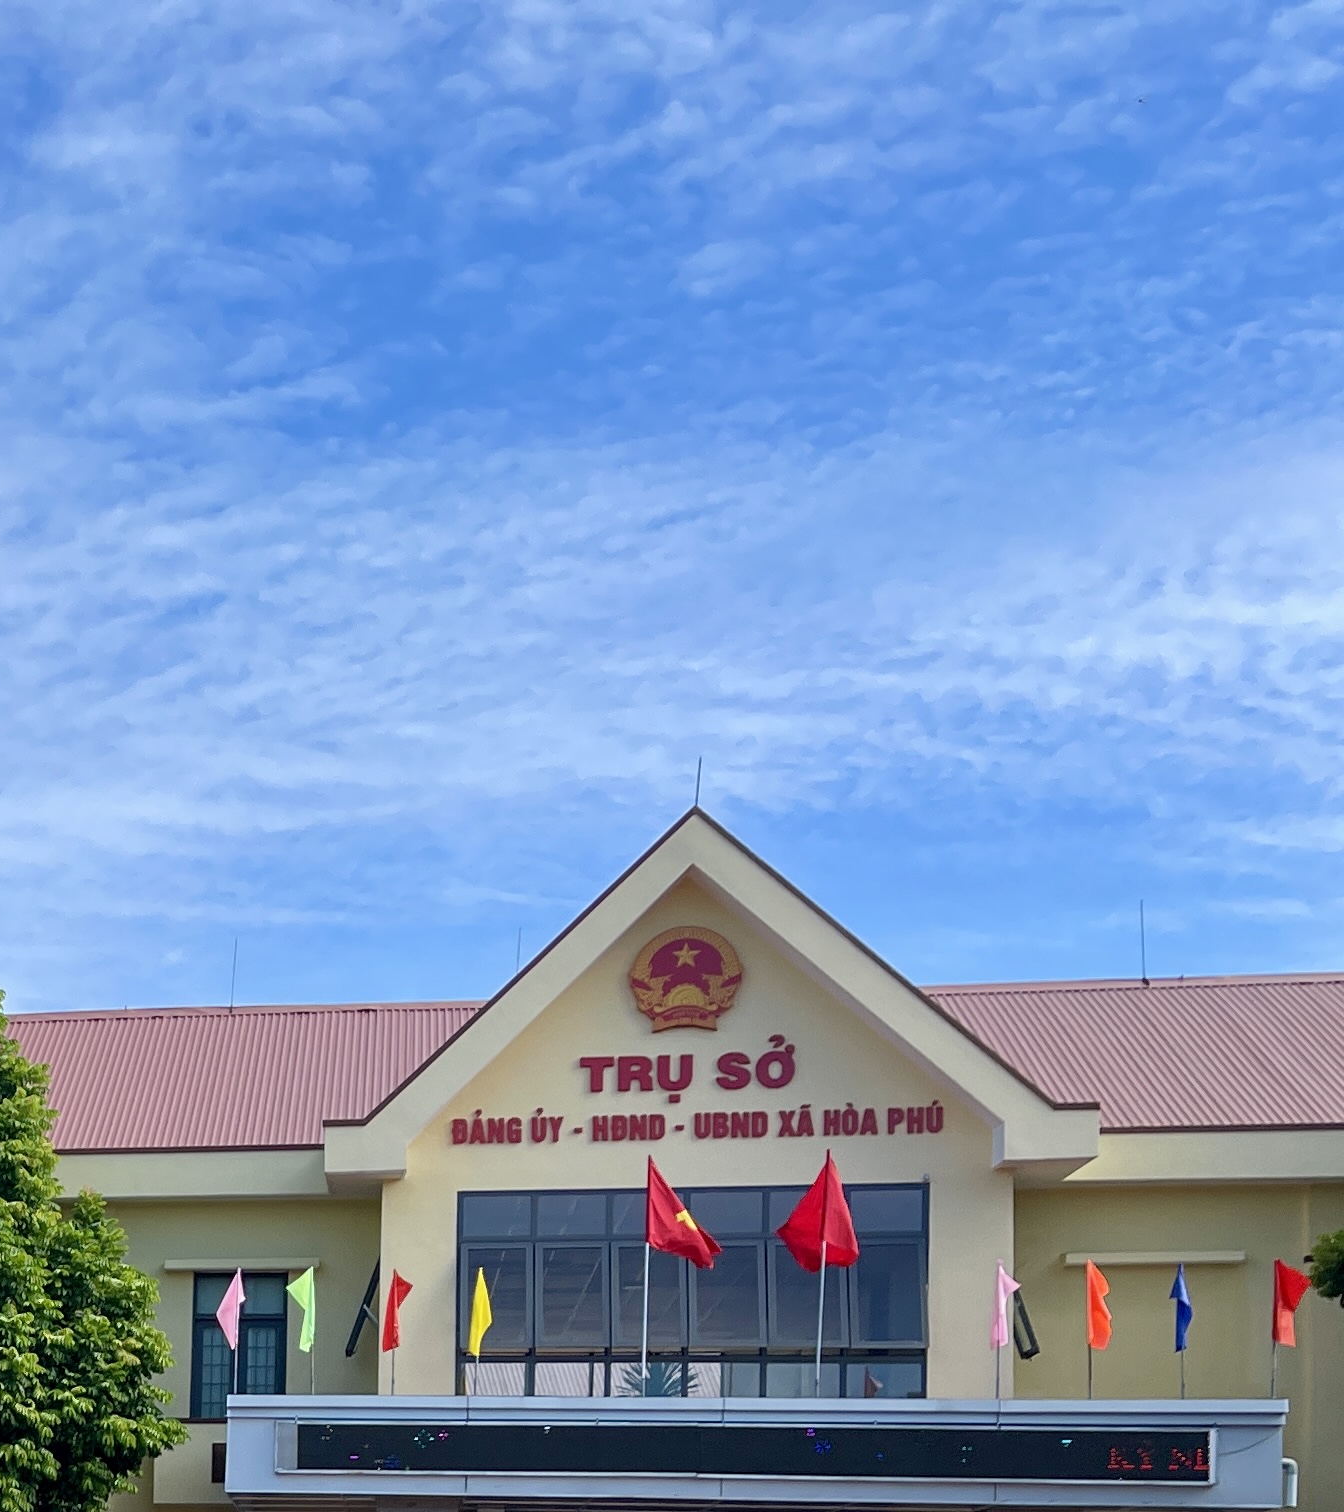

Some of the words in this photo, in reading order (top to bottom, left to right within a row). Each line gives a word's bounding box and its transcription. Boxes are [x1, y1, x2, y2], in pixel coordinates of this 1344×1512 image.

[580, 1054, 694, 1103] TRỤ
[716, 1034, 796, 1090] SỞ
[451, 1109, 523, 1144] ĐẢNG
[531, 1107, 564, 1143] ỦY
[592, 1114, 666, 1142] HĐND
[694, 1111, 768, 1139] UBND
[778, 1104, 814, 1137] XÃ
[823, 1102, 878, 1136] HÒA
[887, 1100, 944, 1135] PHÚ
